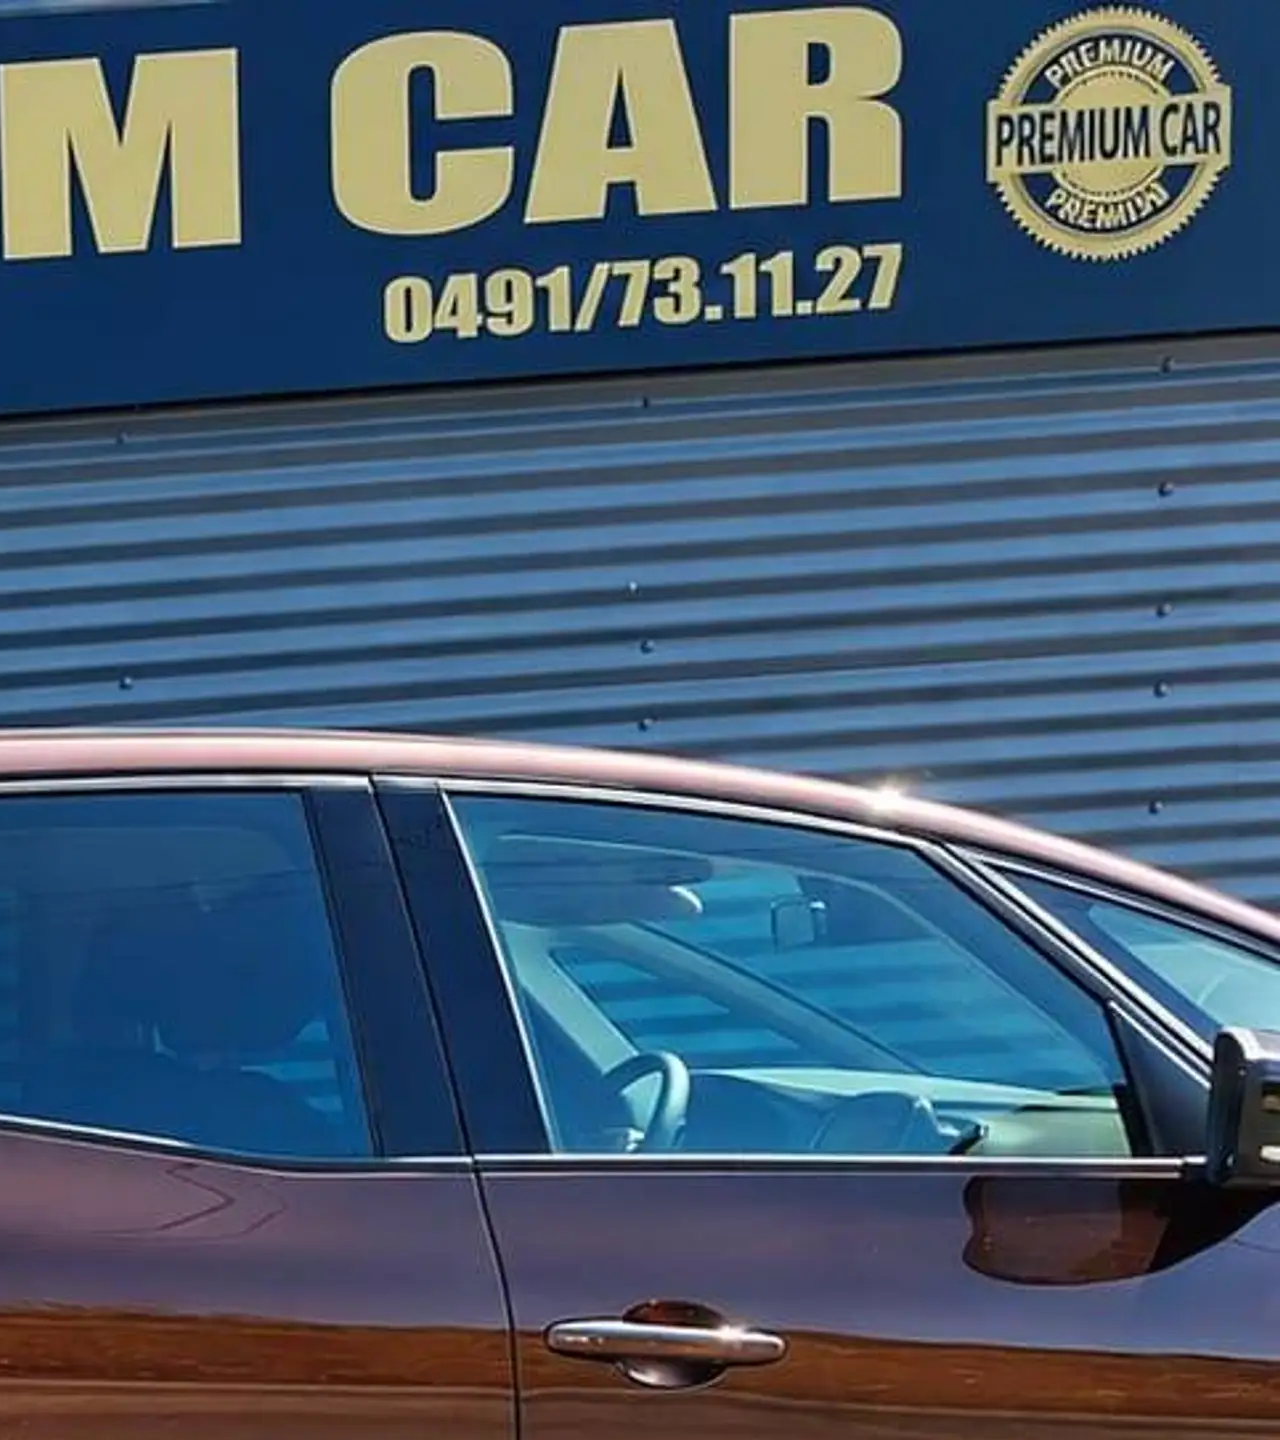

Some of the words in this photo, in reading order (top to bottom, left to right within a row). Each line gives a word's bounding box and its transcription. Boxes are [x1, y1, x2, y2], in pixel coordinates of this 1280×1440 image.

[1043, 38, 1175, 89] PREMIUM
[329, 7, 903, 235] CAR
[995, 105, 1152, 168] PREMIUM
[1159, 101, 1222, 157] CAR
[384, 243, 903, 344] 0491/73.11.27
